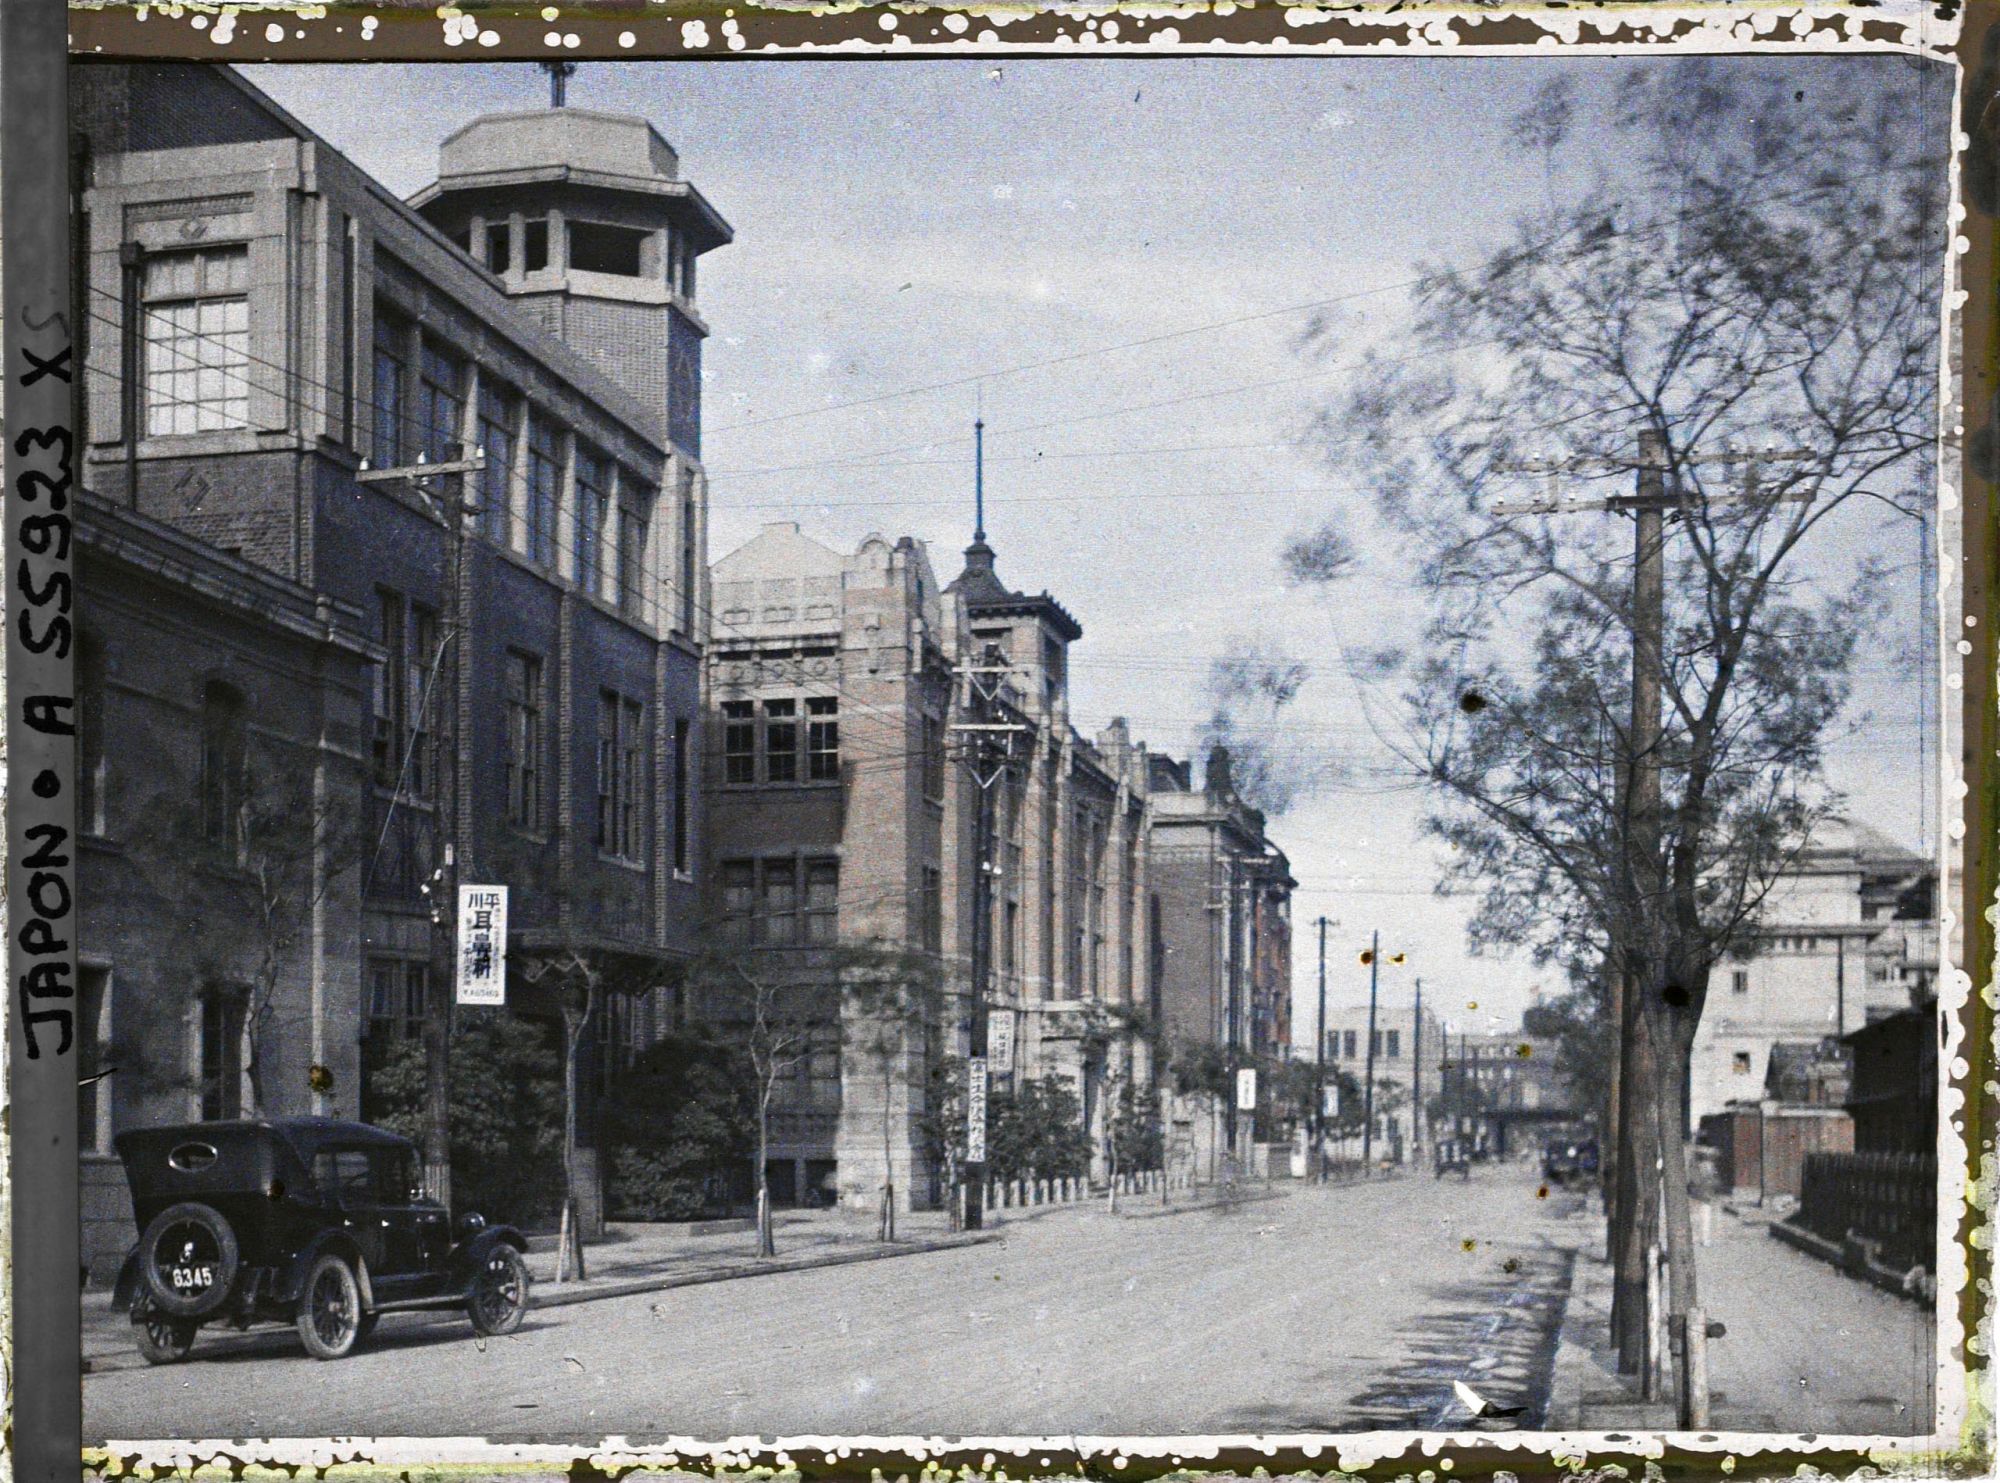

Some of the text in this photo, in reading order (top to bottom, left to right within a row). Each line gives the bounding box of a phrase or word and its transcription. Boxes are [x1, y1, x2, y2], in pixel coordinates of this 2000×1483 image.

[22, 694, 75, 736] A
[19, 822, 73, 1060] JAPON
[173, 1267, 213, 1288] 6345
